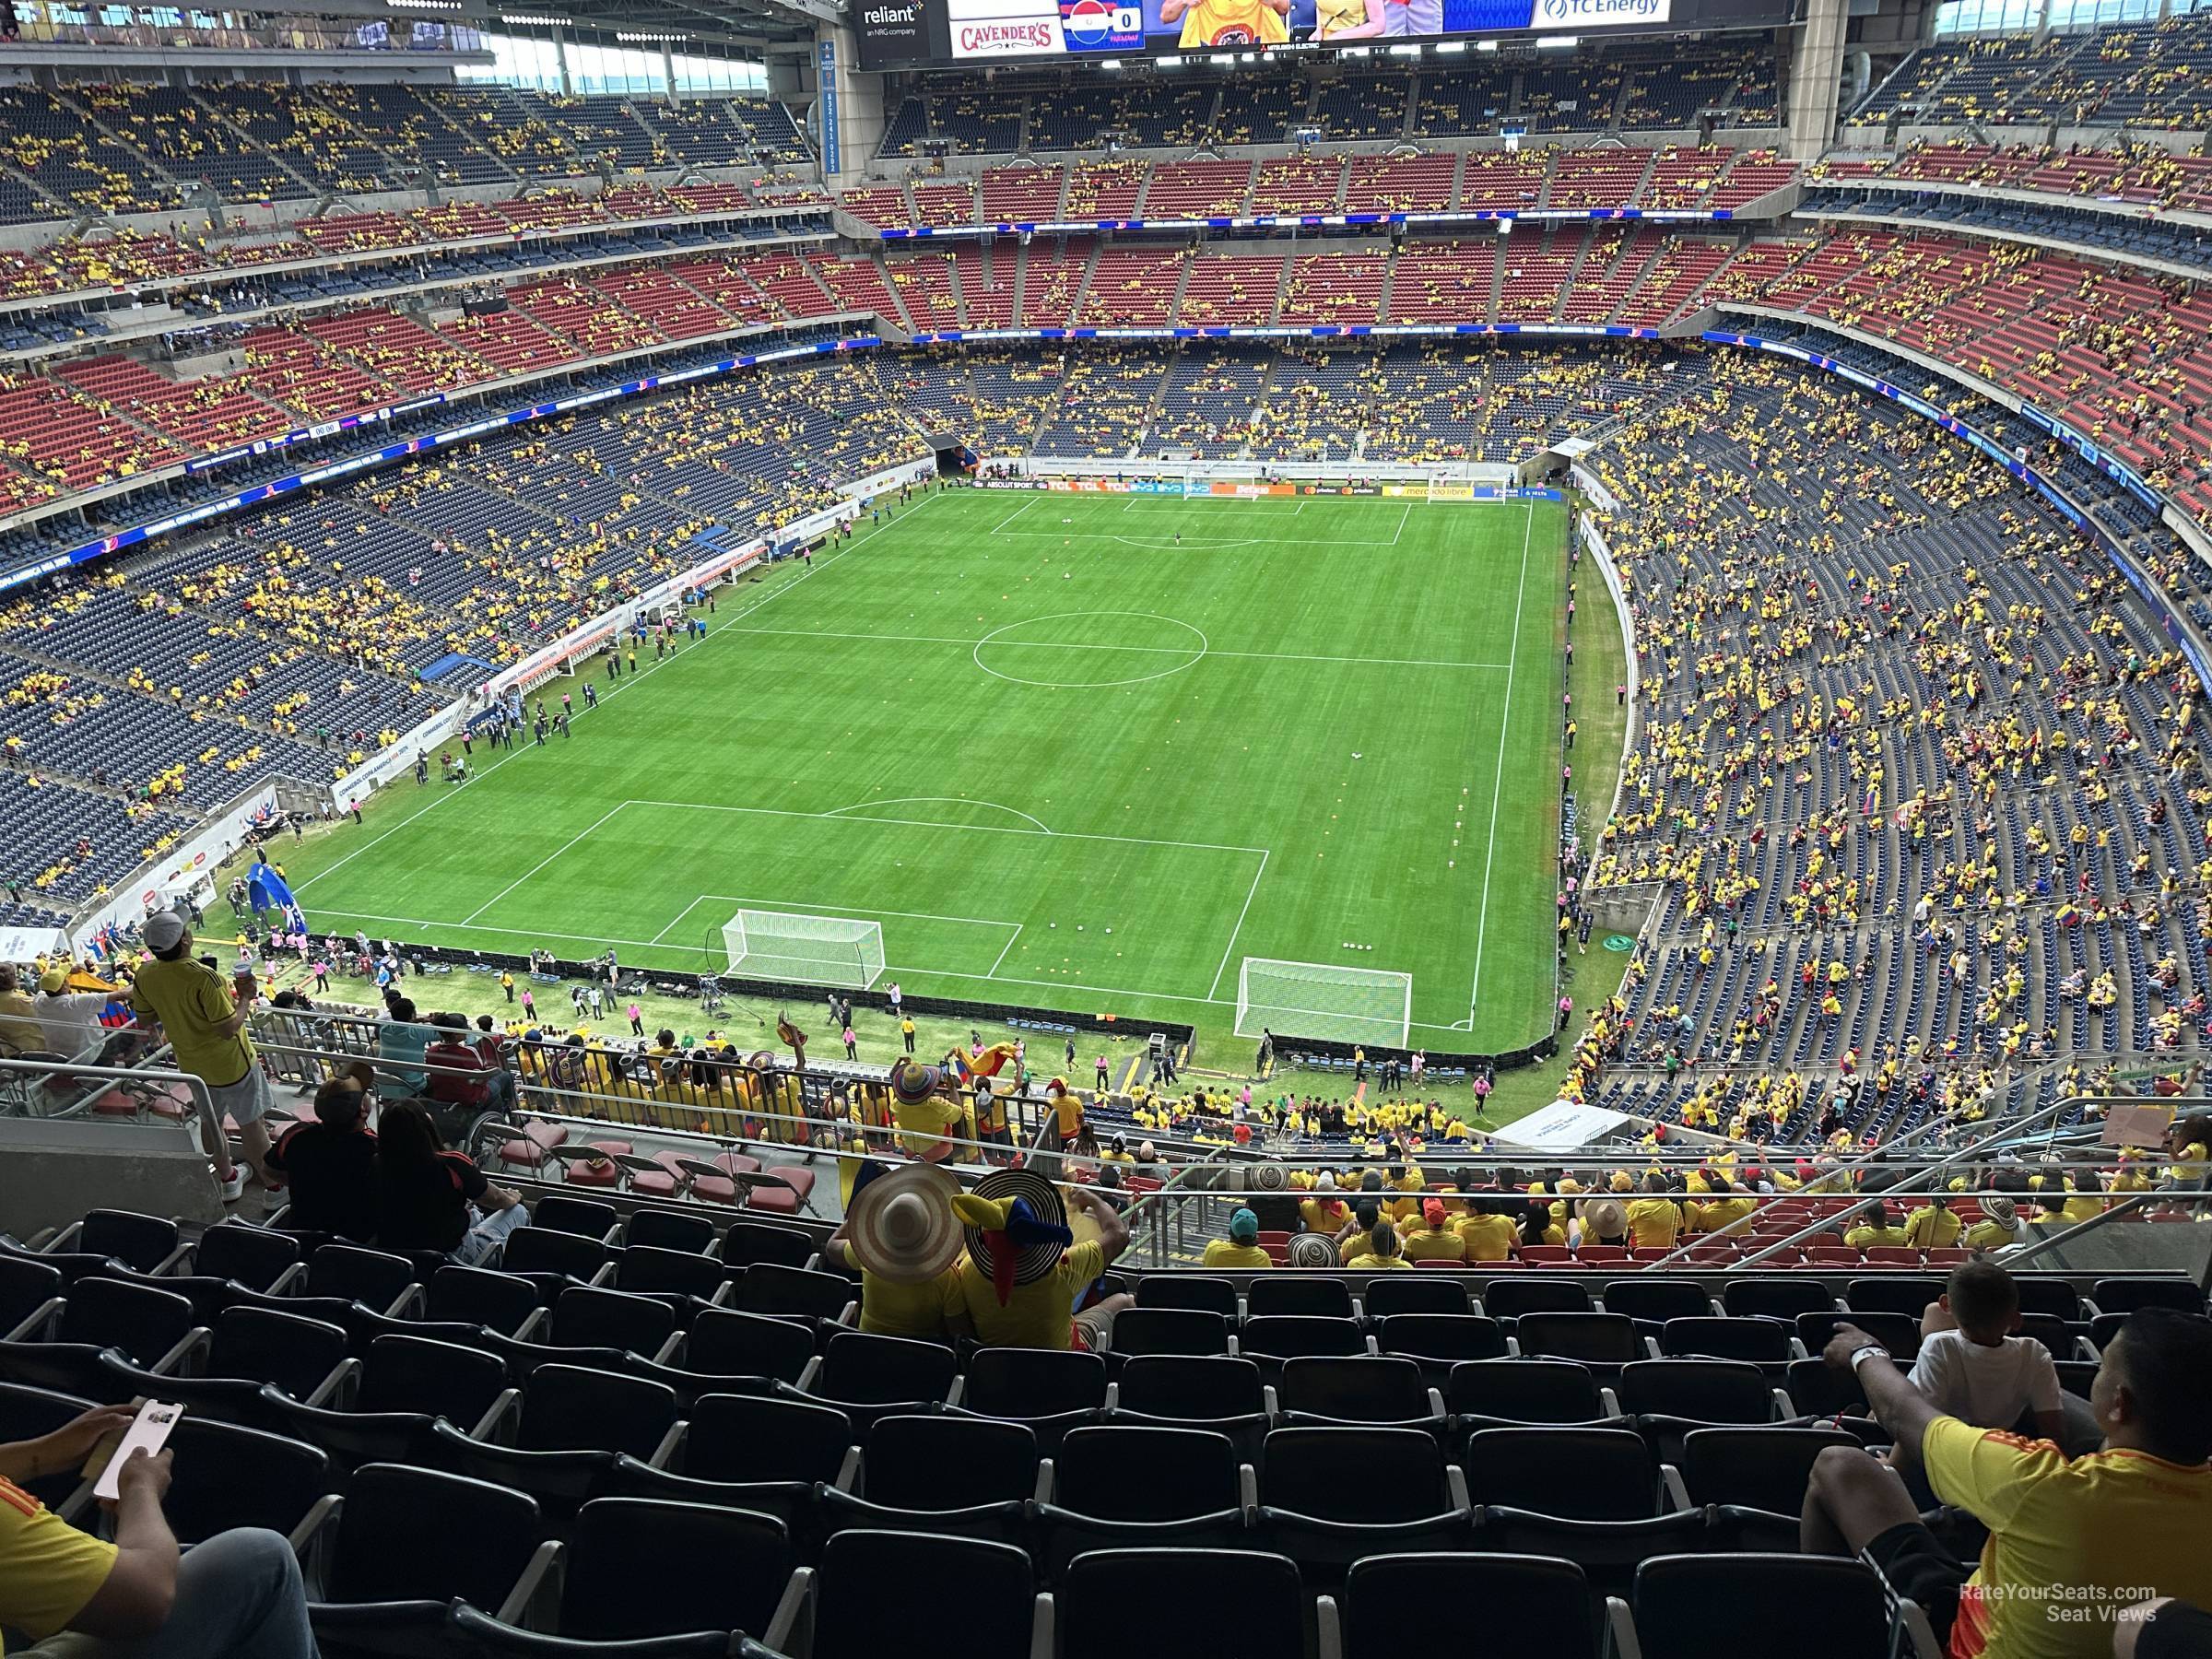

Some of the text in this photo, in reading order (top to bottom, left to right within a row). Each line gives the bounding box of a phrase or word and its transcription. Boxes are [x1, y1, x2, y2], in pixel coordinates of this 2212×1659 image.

[1569, 0, 1658, 15] TC Energy
[865, 6, 914, 24] reliant
[1122, 14, 1131, 28] 0
[888, 29, 916, 37] company
[961, 22, 1052, 51] CAVENDER'S
[987, 481, 1014, 489] ABSOLUT
[1051, 482, 1073, 490] TCL
[1077, 482, 1100, 491] TCL
[1105, 483, 1130, 491] TCL
[1158, 484, 1182, 492] BYD
[1447, 487, 1466, 496] libre
